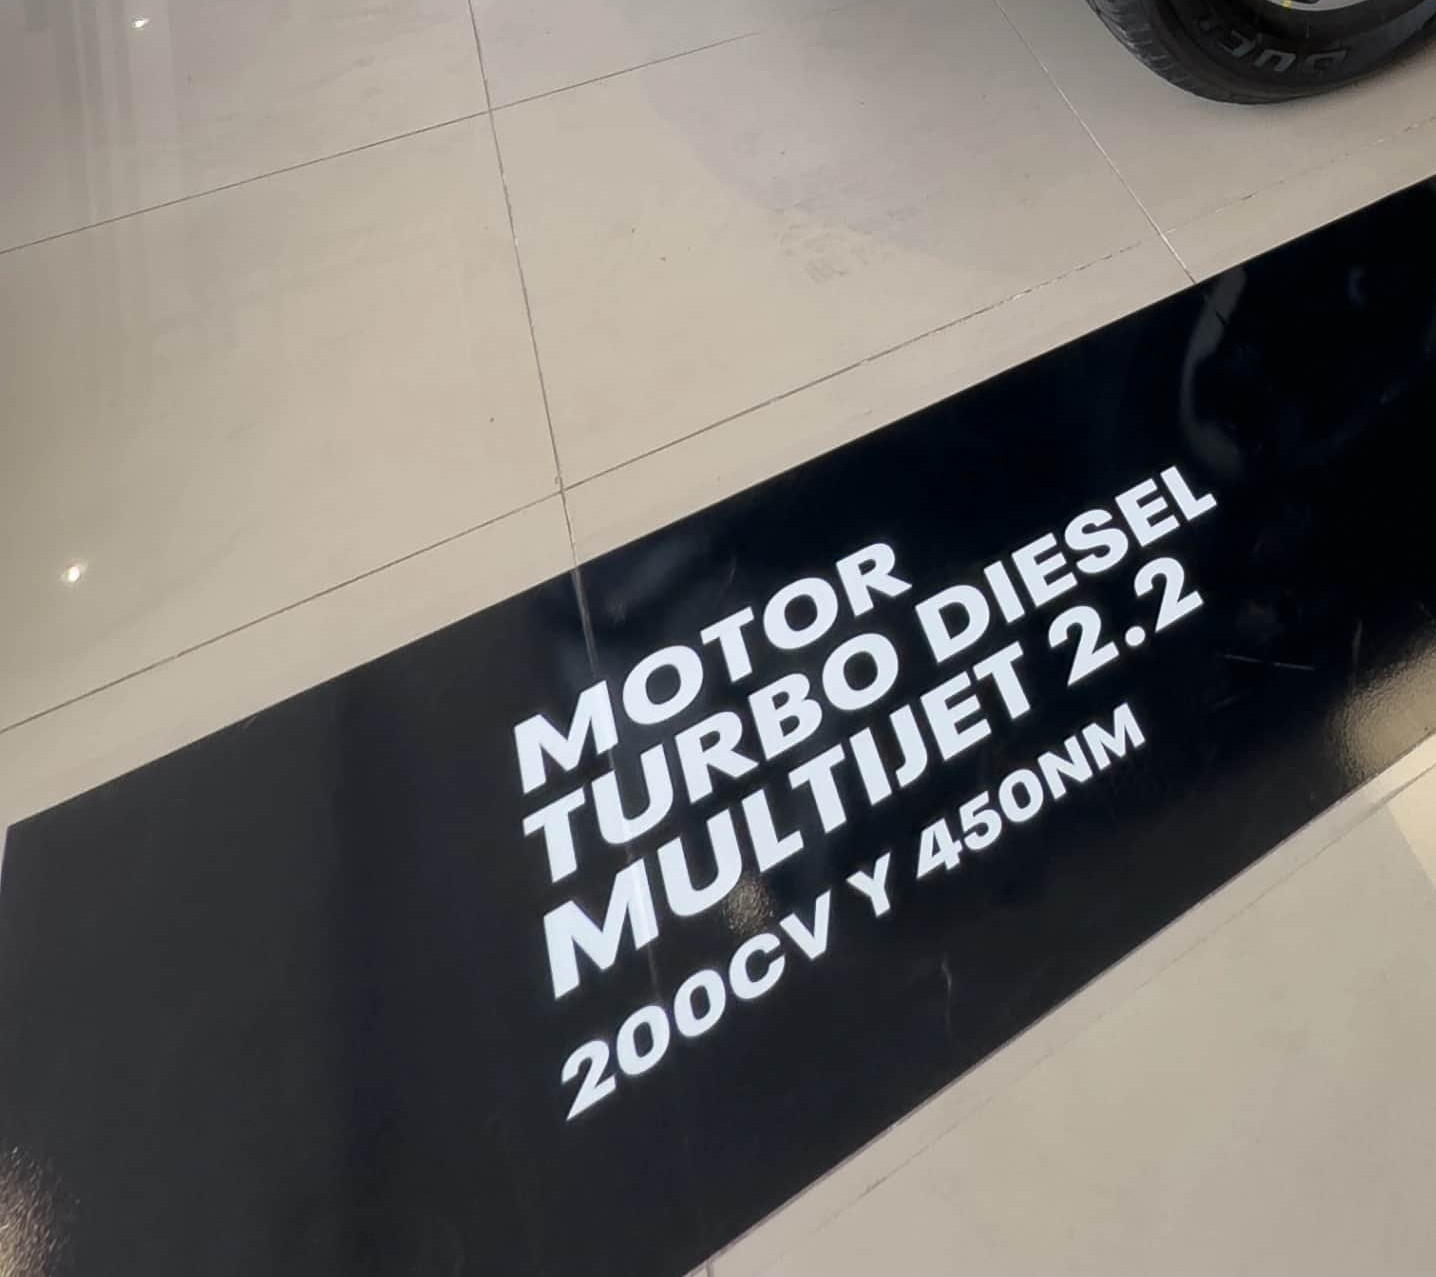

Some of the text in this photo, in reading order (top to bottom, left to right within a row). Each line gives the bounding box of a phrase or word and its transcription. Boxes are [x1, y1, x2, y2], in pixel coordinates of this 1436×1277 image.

[512, 541, 913, 795] MOTOR
[522, 465, 1218, 884] TURBO DIESEL
[543, 556, 1203, 999] MULTIJET 2.2
[560, 702, 1147, 1121] 200CV Y 450NM
